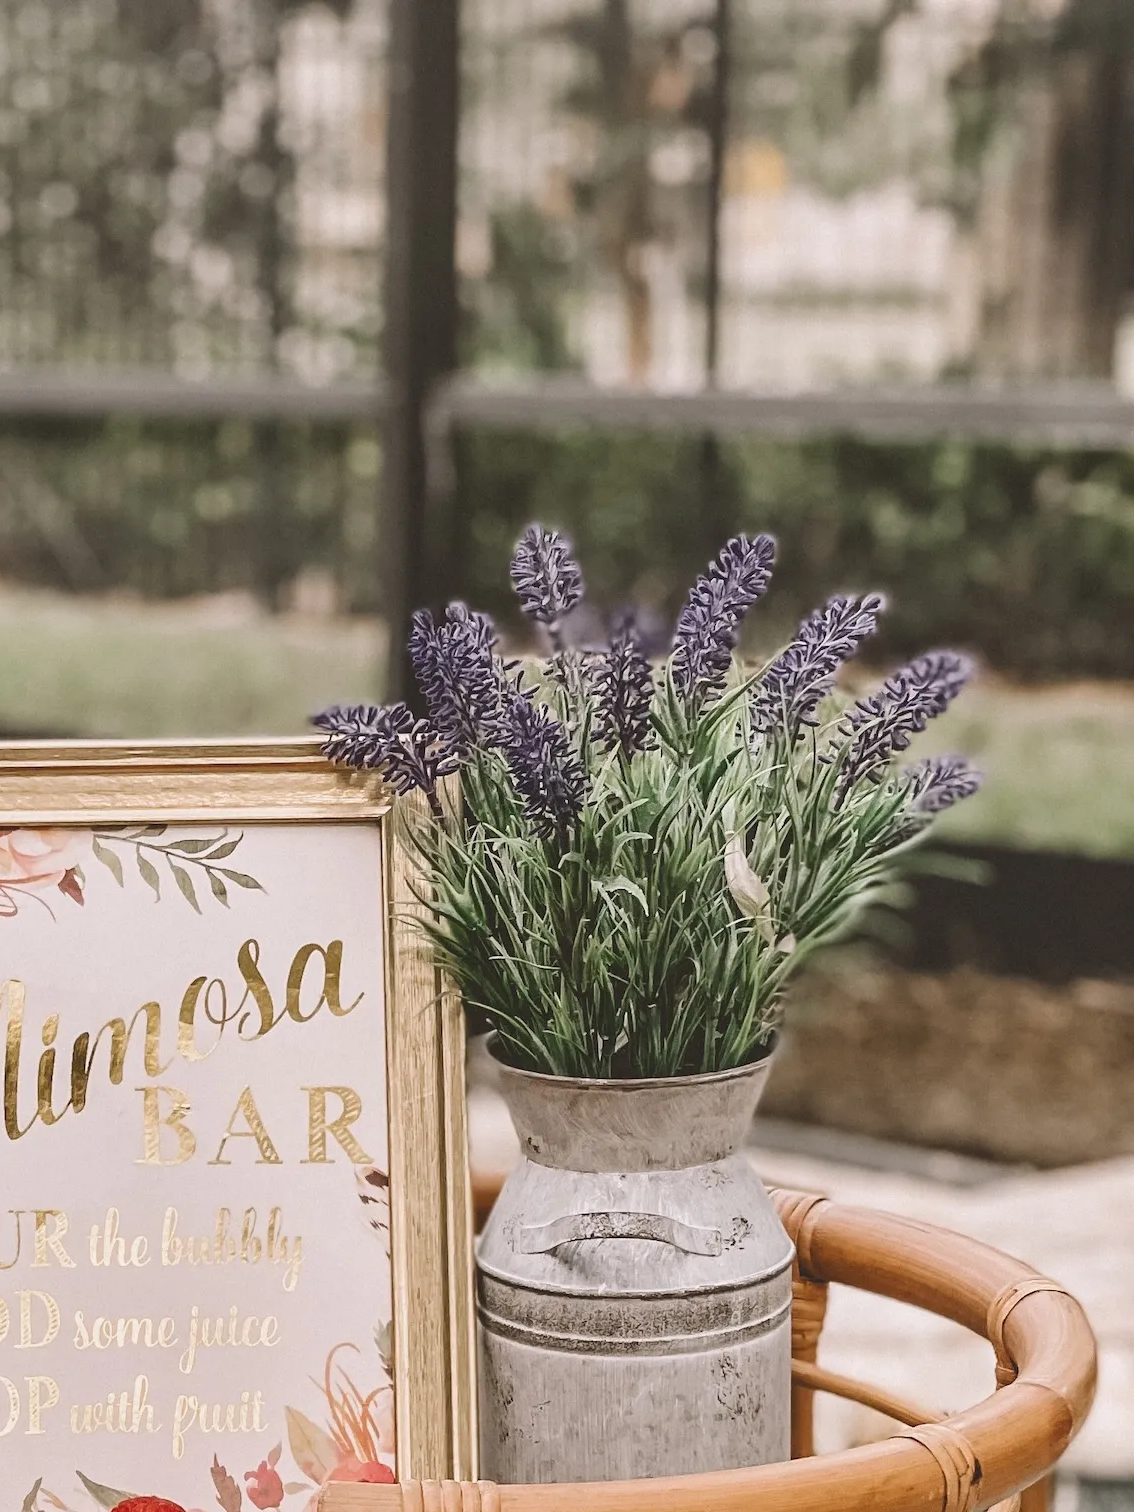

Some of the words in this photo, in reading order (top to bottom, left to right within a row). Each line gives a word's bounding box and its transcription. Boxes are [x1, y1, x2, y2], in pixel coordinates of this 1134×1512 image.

[134, 1085, 375, 1165] BAR
[86, 1206, 149, 1267] the
[161, 1206, 305, 1291] bubbly
[73, 1313, 177, 1349] some
[179, 1304, 281, 1374] juice
[69, 1374, 162, 1435] with
[172, 1389, 268, 1459] fruit
